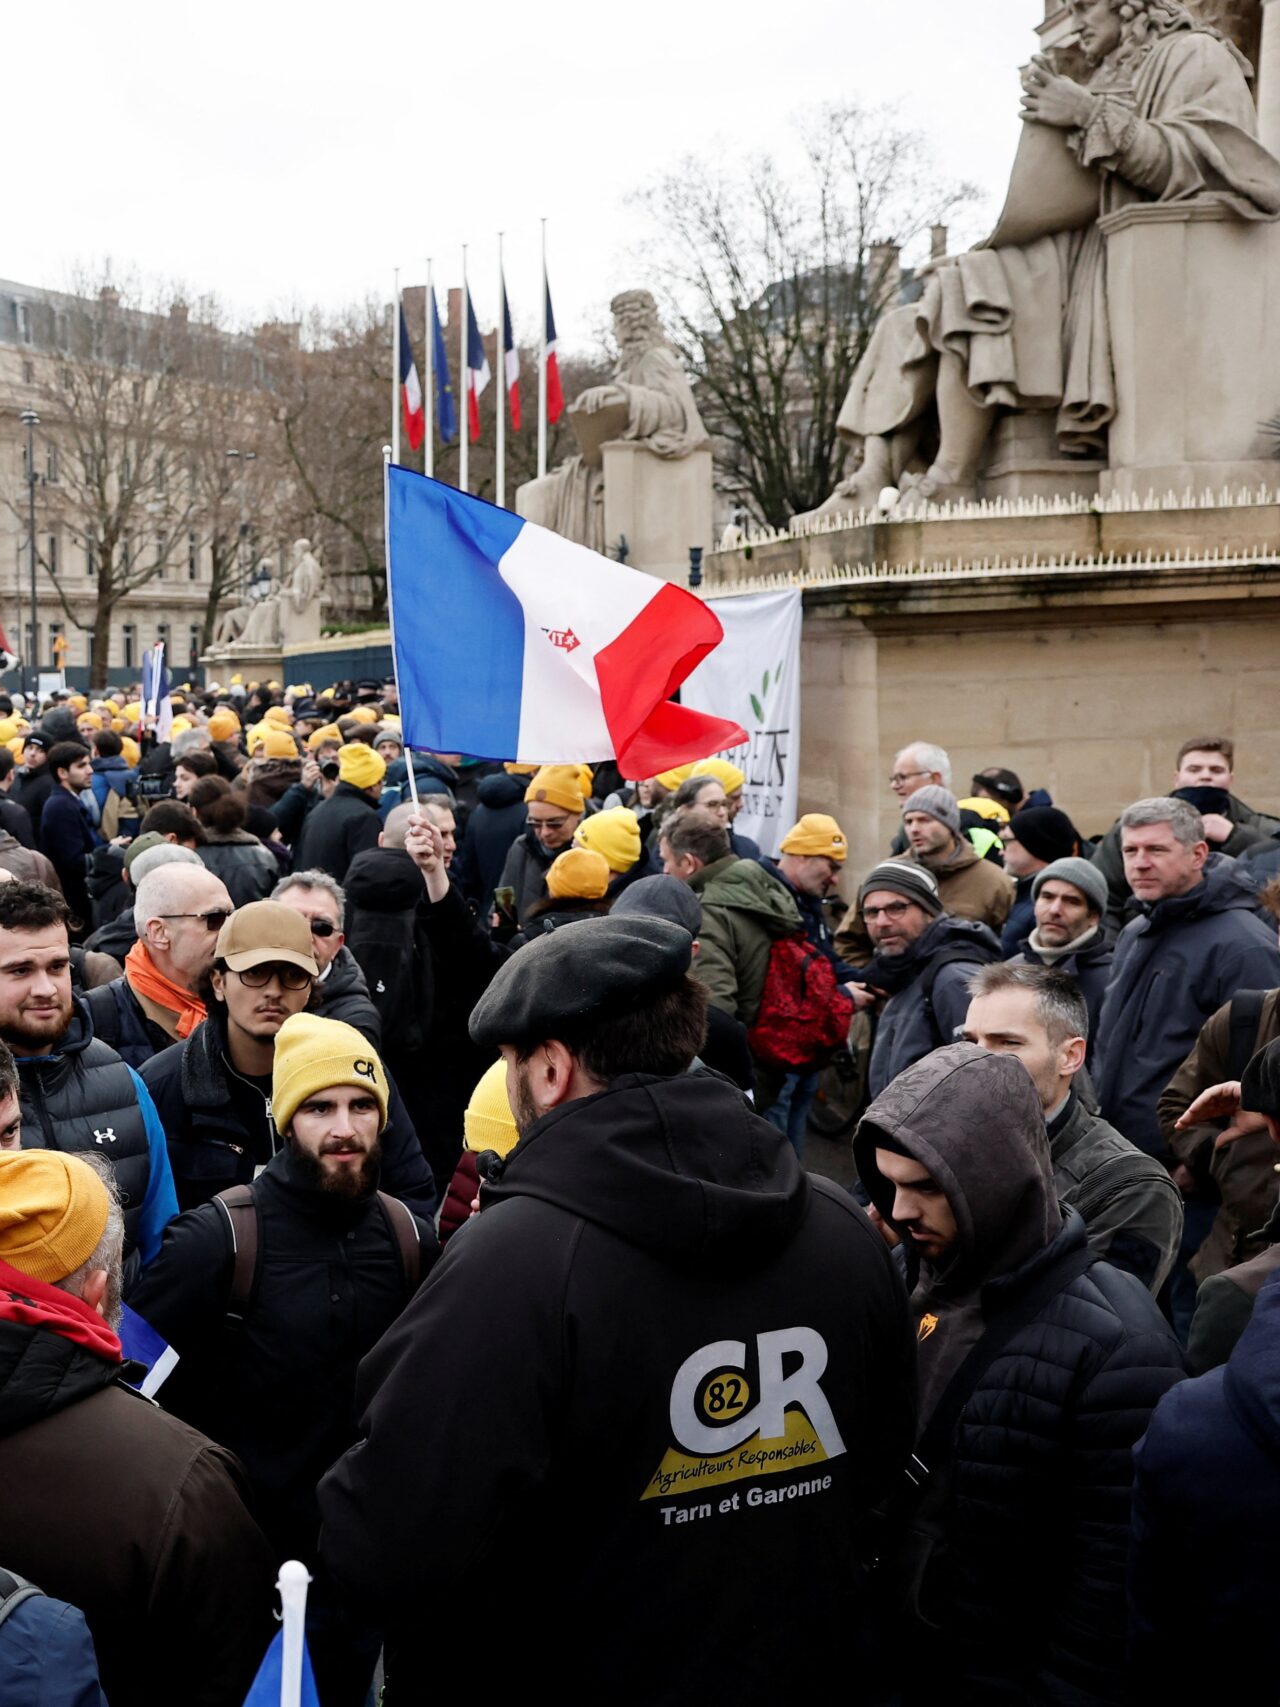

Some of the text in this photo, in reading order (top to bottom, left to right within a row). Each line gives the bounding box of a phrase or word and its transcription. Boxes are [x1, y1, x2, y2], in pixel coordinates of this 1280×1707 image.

[353, 1058, 377, 1084] CR
[669, 1325, 848, 1460] CR
[707, 1377, 744, 1413] 82
[651, 1439, 817, 1494] Agriculteurs Responsables
[660, 1474, 833, 1526] Tarn et Garonne
